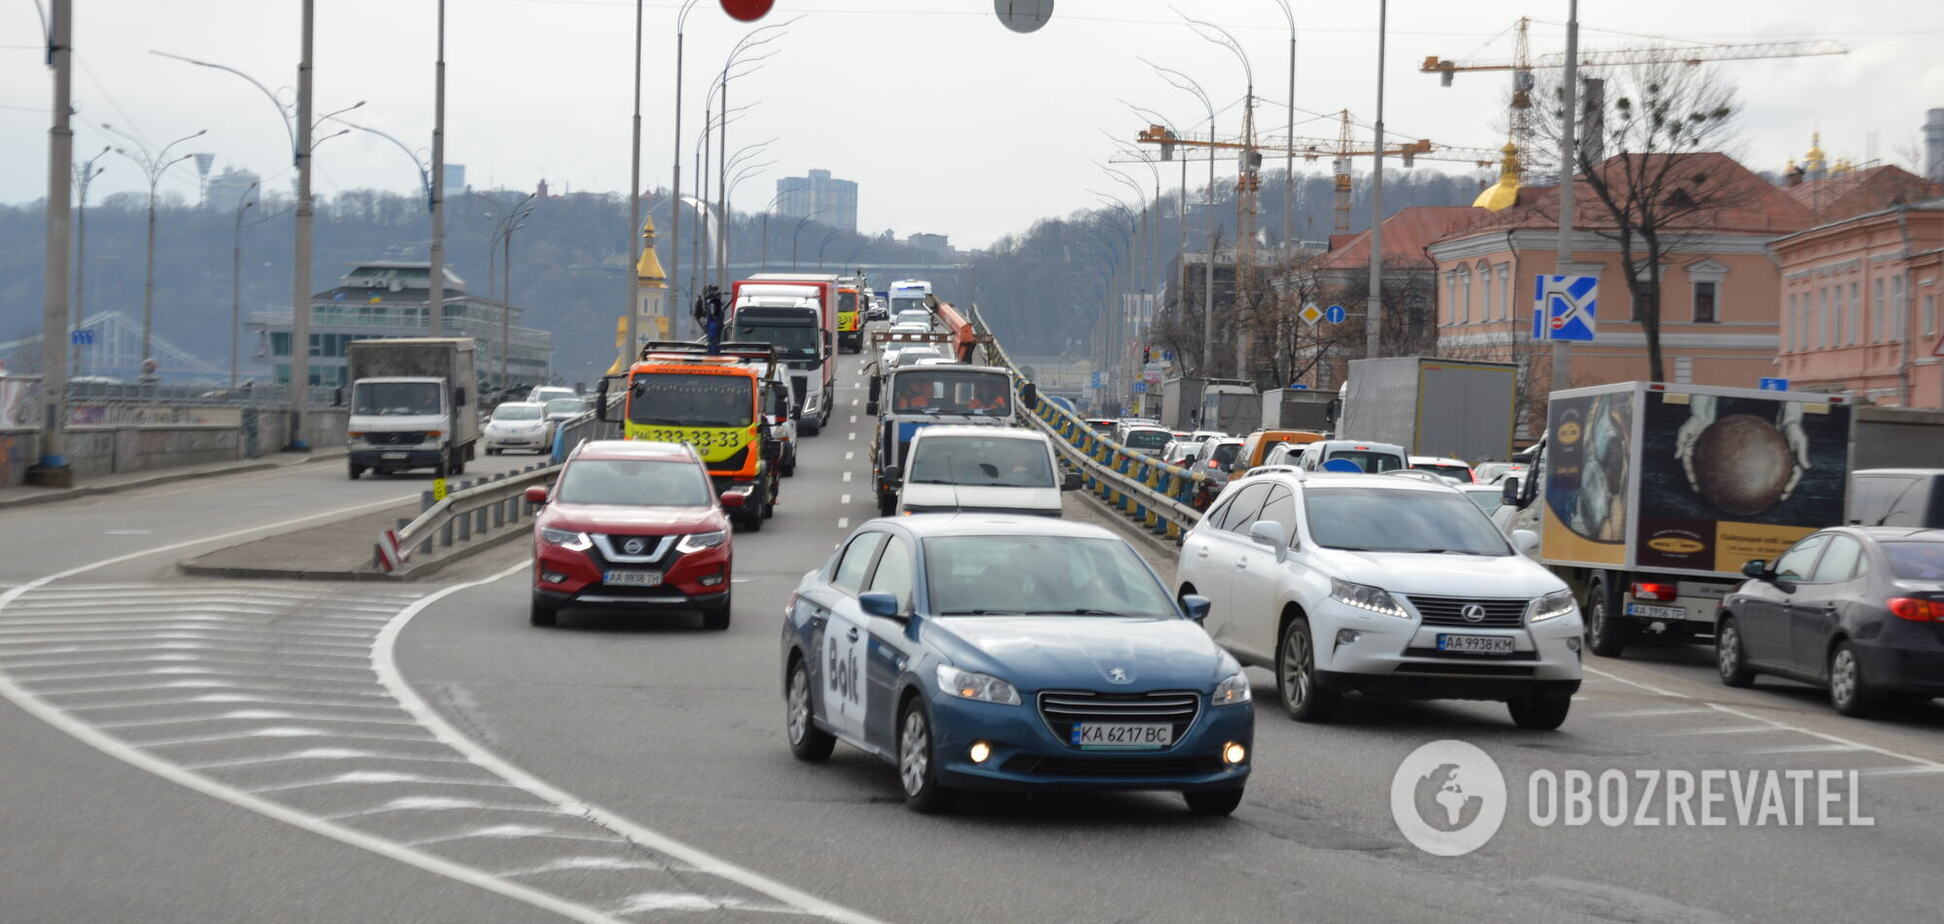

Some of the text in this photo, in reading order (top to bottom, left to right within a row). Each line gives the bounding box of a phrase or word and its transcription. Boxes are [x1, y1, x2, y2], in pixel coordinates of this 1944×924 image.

[1446, 636, 1513, 651] AA 9938 KM
[828, 637, 859, 706] Bolt
[1081, 726, 1168, 743] KA 6217 BC
